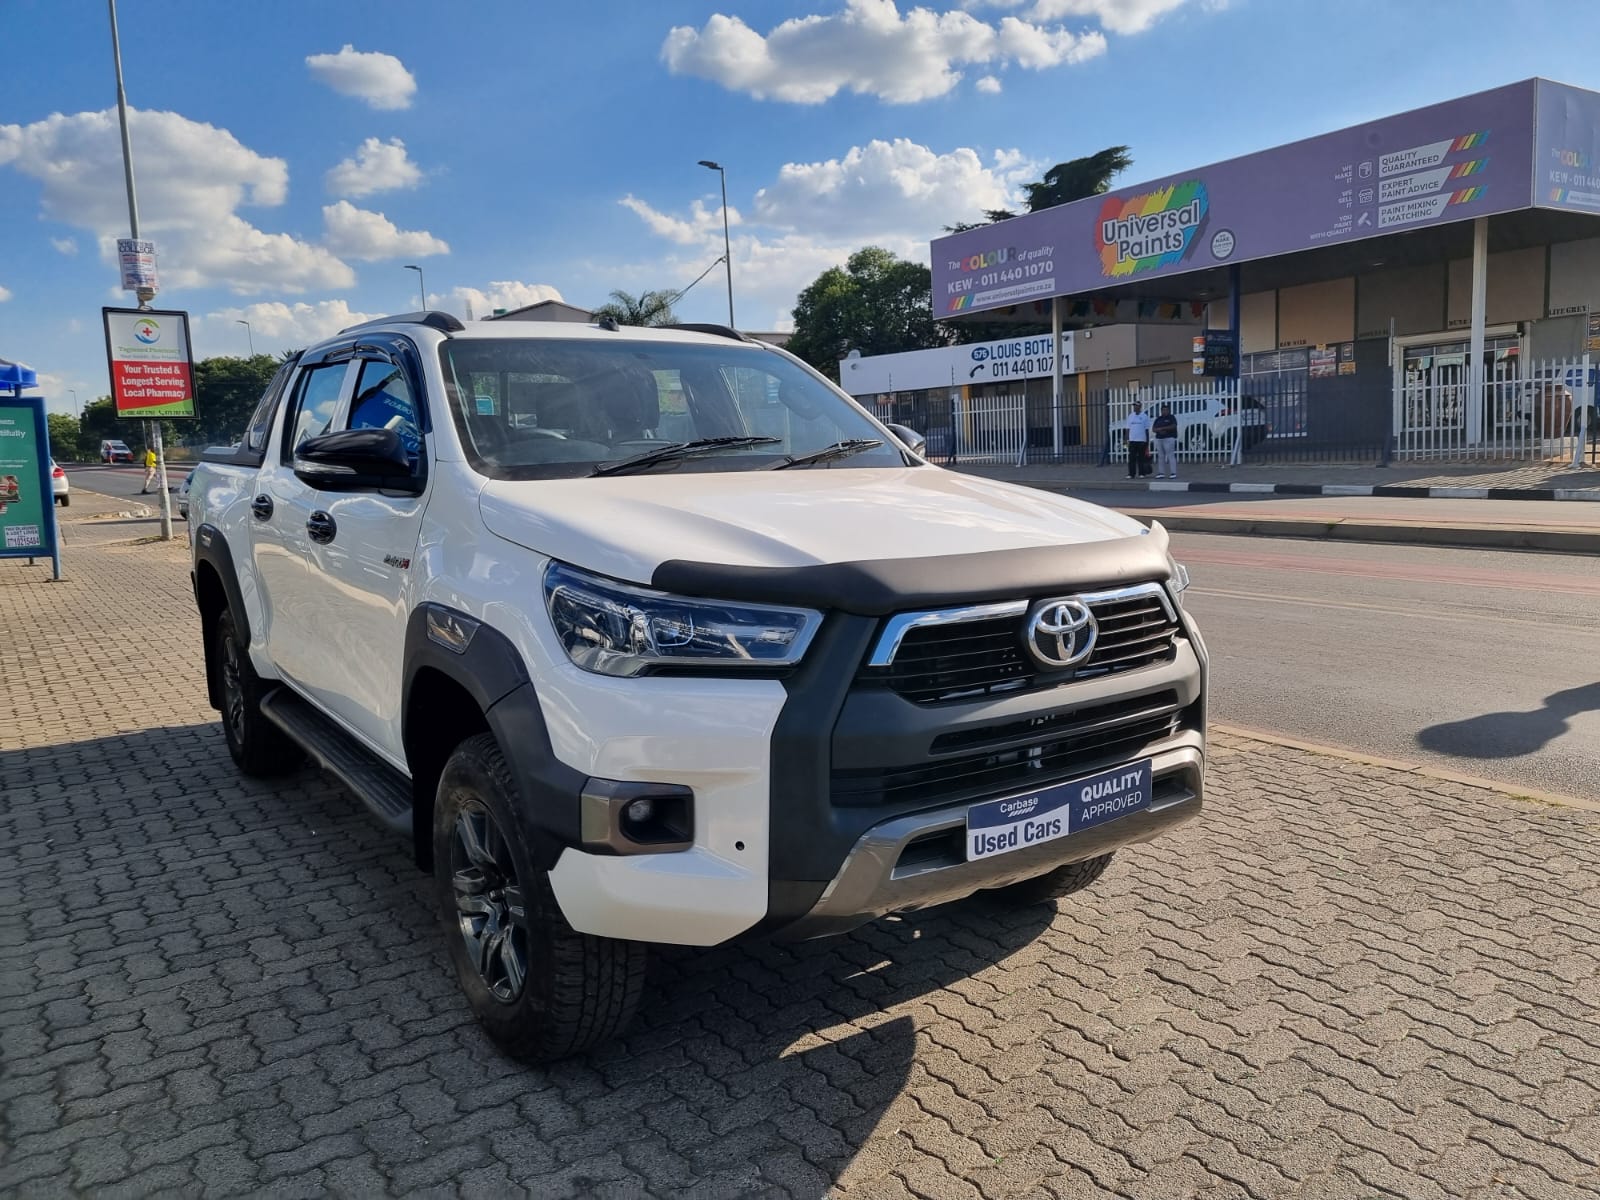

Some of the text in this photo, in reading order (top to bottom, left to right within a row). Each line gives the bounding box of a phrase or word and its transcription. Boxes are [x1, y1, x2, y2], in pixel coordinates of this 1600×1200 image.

[1382, 151, 1418, 166] QUALITY
[1382, 155, 1440, 173] GUARANTEED
[1335, 172, 1352, 180] MAKE
[1382, 178, 1414, 191] EXPERT
[1550, 170, 1568, 185] KEW
[1382, 181, 1440, 199] PAINT ADVICE
[1381, 199, 1438, 216] PAINT MIXING
[1388, 209, 1432, 223] MATCHING
[1103, 200, 1199, 244] Universal
[1334, 221, 1352, 229] PAINT
[1327, 227, 1352, 237] QUALITY
[1119, 229, 1183, 261] Paints
[948, 246, 1054, 272] The COLOUR of quality
[948, 278, 972, 294] KEW
[981, 272, 998, 286] 011
[1000, 267, 1022, 282] 440
[1024, 261, 1053, 277] 1070
[991, 338, 1054, 361] LOUIS BOTH
[124, 364, 180, 374] Your Trusted &
[993, 362, 1009, 376] 011
[1012, 359, 1034, 374] 440
[122, 376, 185, 388] Longest Serving
[123, 388, 186, 399] Local Pharmacy
[1081, 770, 1142, 803] QUALITY
[1000, 797, 1039, 813] Carbase
[1081, 791, 1142, 822] APPROVED
[974, 818, 1061, 856] Used Cars
